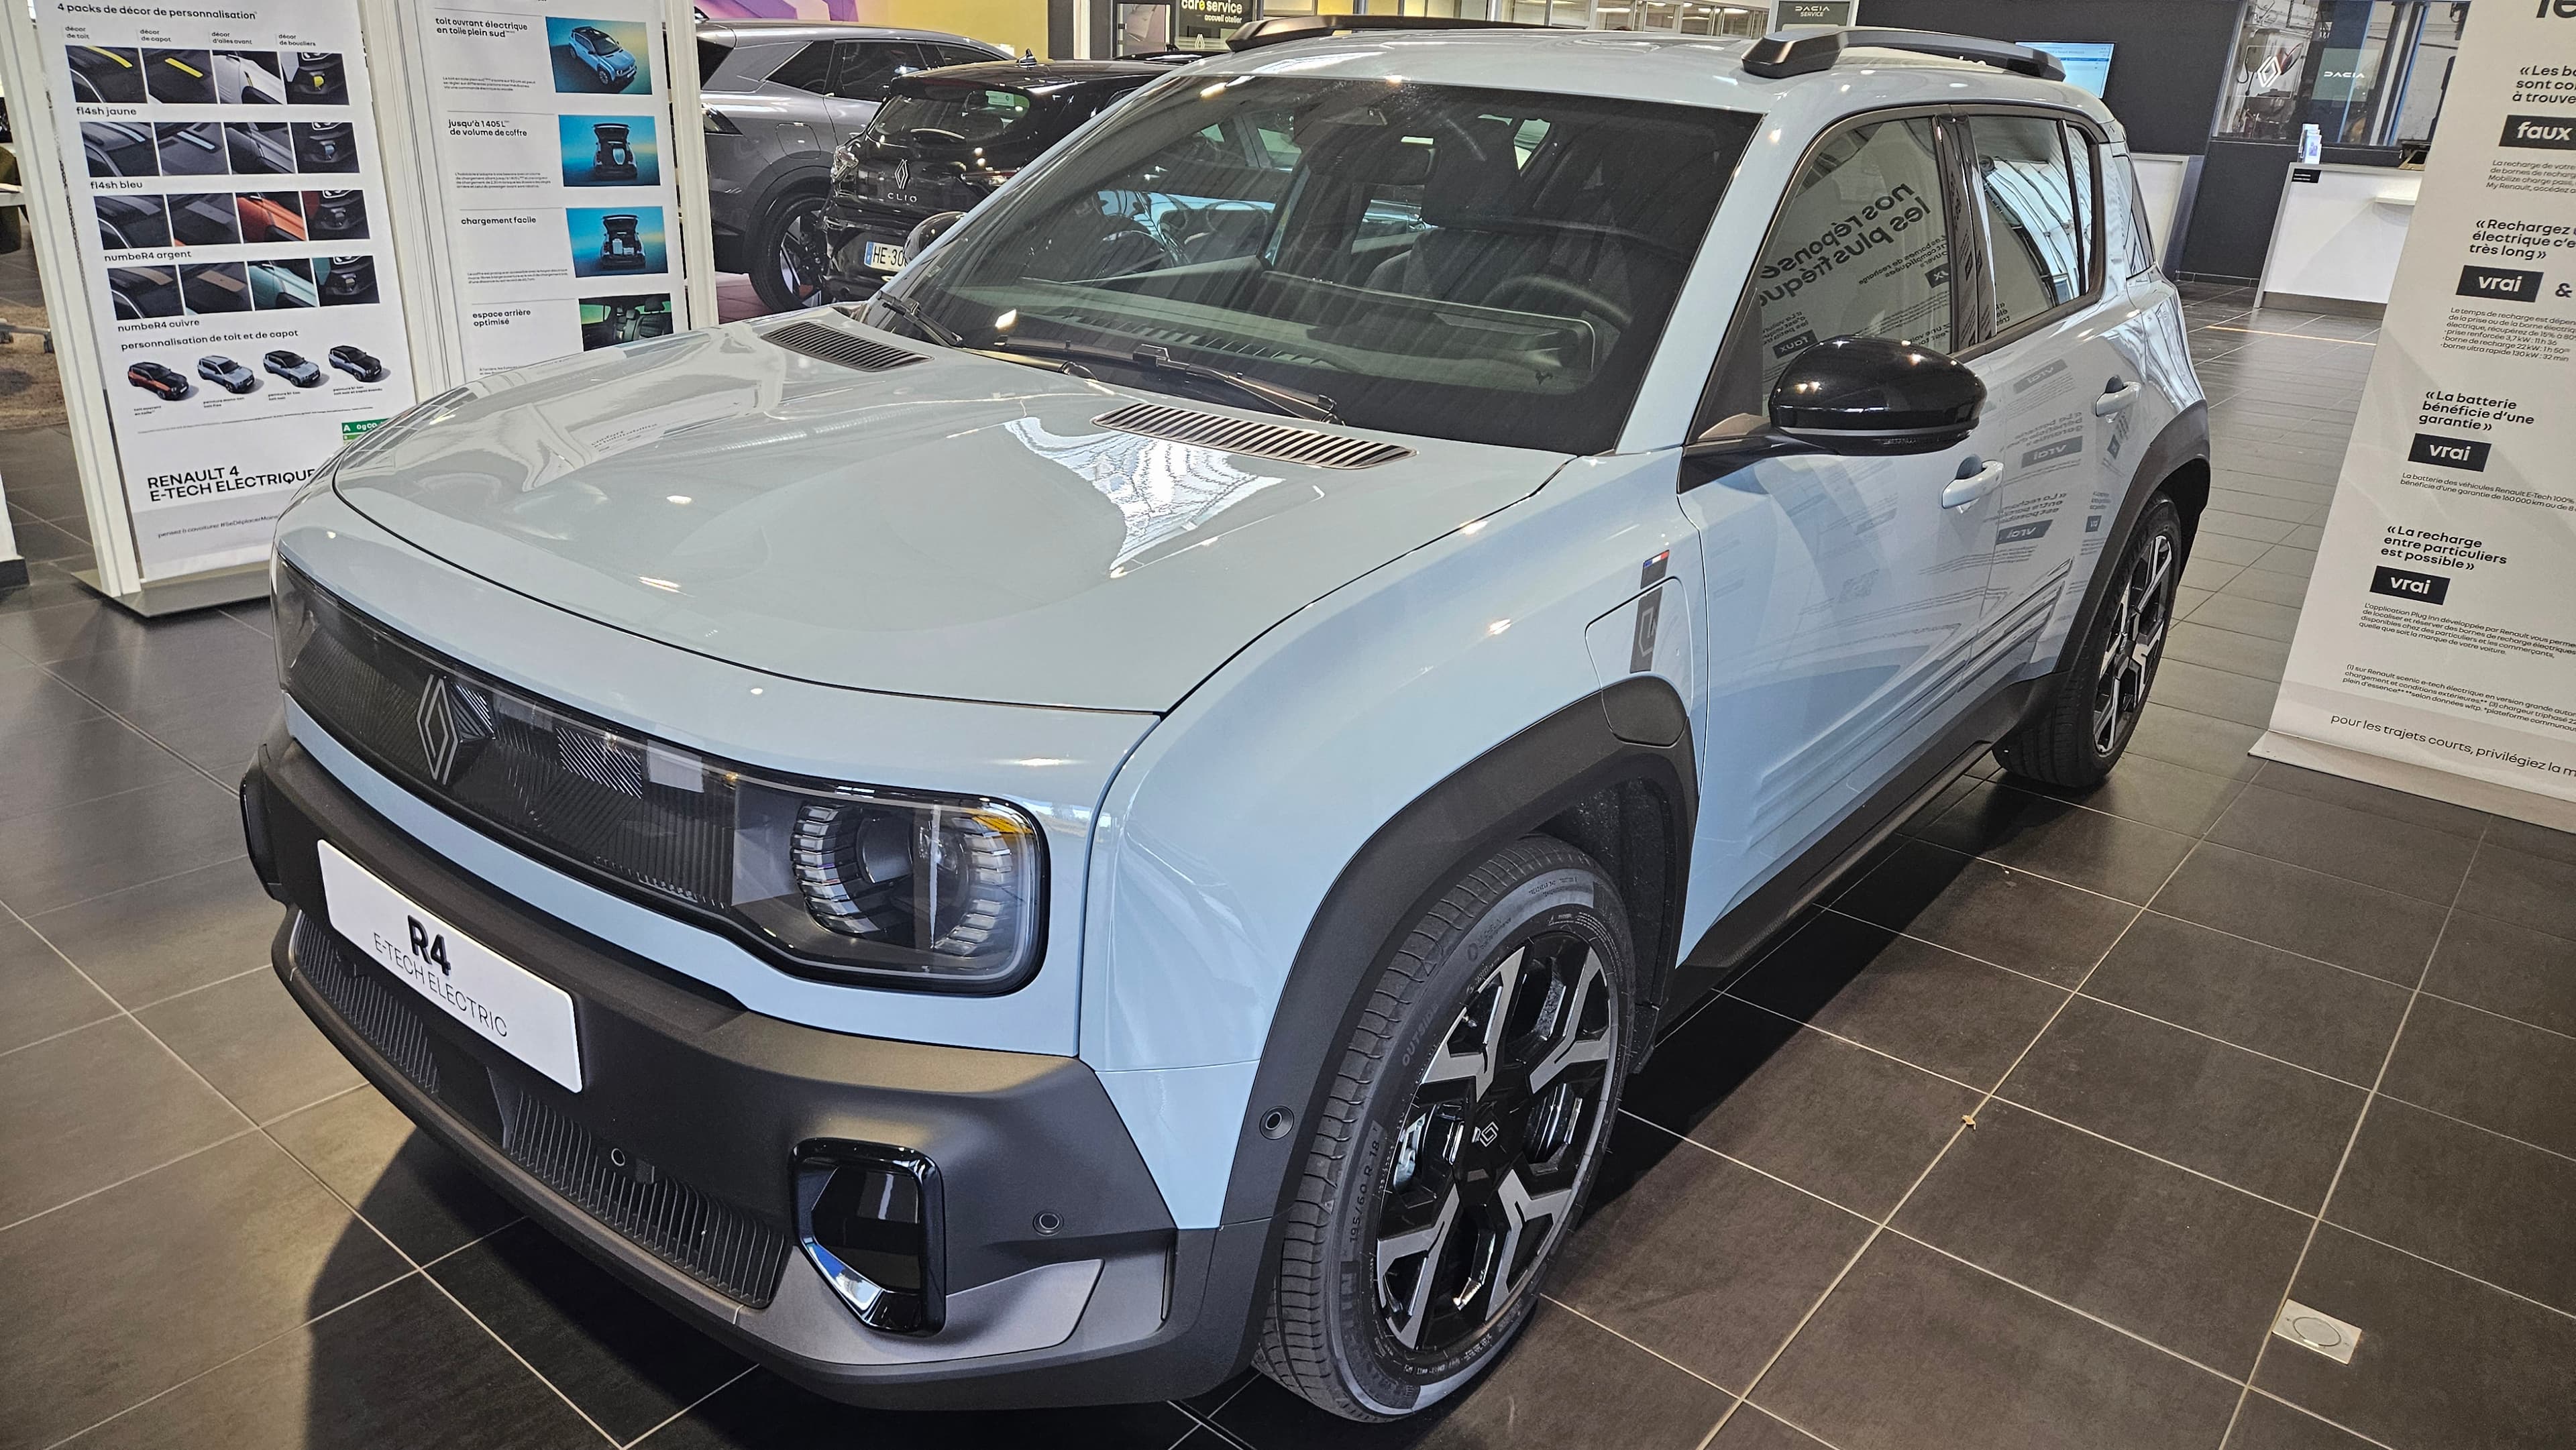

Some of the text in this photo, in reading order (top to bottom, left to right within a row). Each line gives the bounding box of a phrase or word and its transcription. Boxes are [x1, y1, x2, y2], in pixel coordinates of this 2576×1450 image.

[67, 4, 101, 13] packs
[103, 5, 117, 13] de
[119, 6, 150, 15] décor
[153, 7, 167, 16] de
[169, 9, 256, 19] personnalisation
[1181, 0, 1243, 13] care service
[468, 28, 488, 37] plein
[485, 20, 528, 32] électrique
[2516, 80, 2576, 91] sont co
[2512, 91, 2523, 102] à
[76, 107, 137, 117] fl4sh jaune
[2517, 121, 2573, 141] faux
[91, 180, 143, 190] fl4sh bleu
[888, 192, 918, 203] CLIO
[461, 217, 513, 225] chargement
[2472, 230, 2550, 247] électrique
[105, 251, 192, 262] numbeR4 argent
[873, 245, 908, 267] HE-30
[2469, 243, 2498, 255] très
[2478, 276, 2573, 298] vrai &
[472, 309, 531, 319] espace arrière
[473, 318, 510, 327] optimisé
[118, 319, 200, 332] numbeR4 cuivre
[121, 336, 208, 351] personnalisation
[224, 332, 241, 341] toit
[270, 330, 299, 339] capot
[2457, 392, 2517, 410] batterie
[2422, 400, 2534, 425] bénéficie d'une
[2429, 444, 2471, 461] vrai
[147, 465, 239, 489] RENAULT 4
[2412, 473, 2443, 484] batterie
[2444, 478, 2457, 486] des
[2459, 480, 2494, 492] véhicules
[2495, 487, 2526, 497] Renault
[150, 482, 212, 502] E-TECH
[2400, 479, 2435, 490] bénéficie
[2457, 488, 2490, 498] garantie
[2417, 530, 2483, 549] recharge
[2381, 548, 2404, 558] est
[2383, 537, 2508, 564] entre particuliers
[2390, 577, 2431, 594] vrai
[2410, 612, 2427, 620] Plug
[2440, 616, 2484, 628] développée
[2500, 628, 2530, 639] Renault
[2330, 714, 2362, 728] pour
[2363, 720, 2381, 732] les
[2383, 725, 2426, 742] trajets
[2428, 736, 2474, 755] courts,
[2475, 746, 2546, 770] privilégiez
[2548, 762, 2561, 774] la
[407, 914, 452, 977] R4
[373, 932, 507, 1038] E-TECH ELECTRIC
